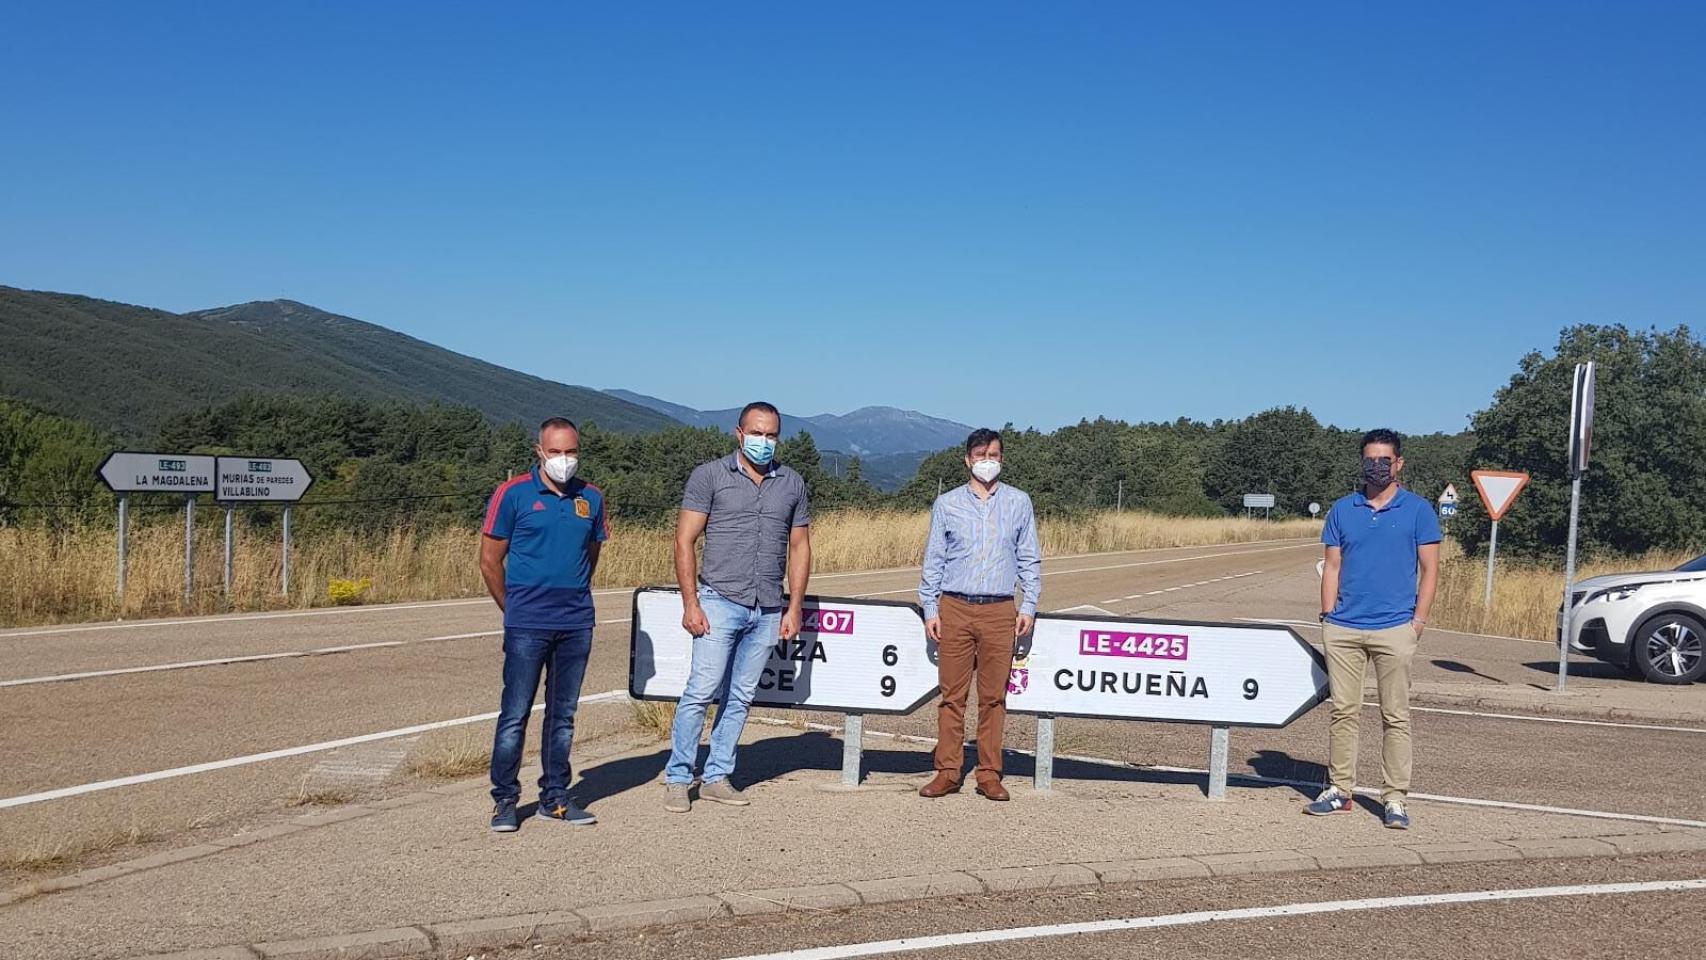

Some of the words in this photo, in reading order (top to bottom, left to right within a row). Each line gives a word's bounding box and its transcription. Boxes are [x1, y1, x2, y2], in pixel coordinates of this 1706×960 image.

[135, 475, 148, 485] LA
[152, 475, 209, 486] MAGDALENA
[222, 473, 254, 484] MURIAS
[256, 476, 265, 484] DE
[266, 476, 294, 484] PAREDES
[222, 486, 270, 497] VILLABLINO
[801, 611, 852, 631] 407
[882, 644, 899, 667] 6
[1083, 633, 1185, 657] LE-4425
[880, 675, 897, 698] 9
[1053, 668, 1209, 699] CURUEÑA
[1242, 678, 1259, 701] 9
